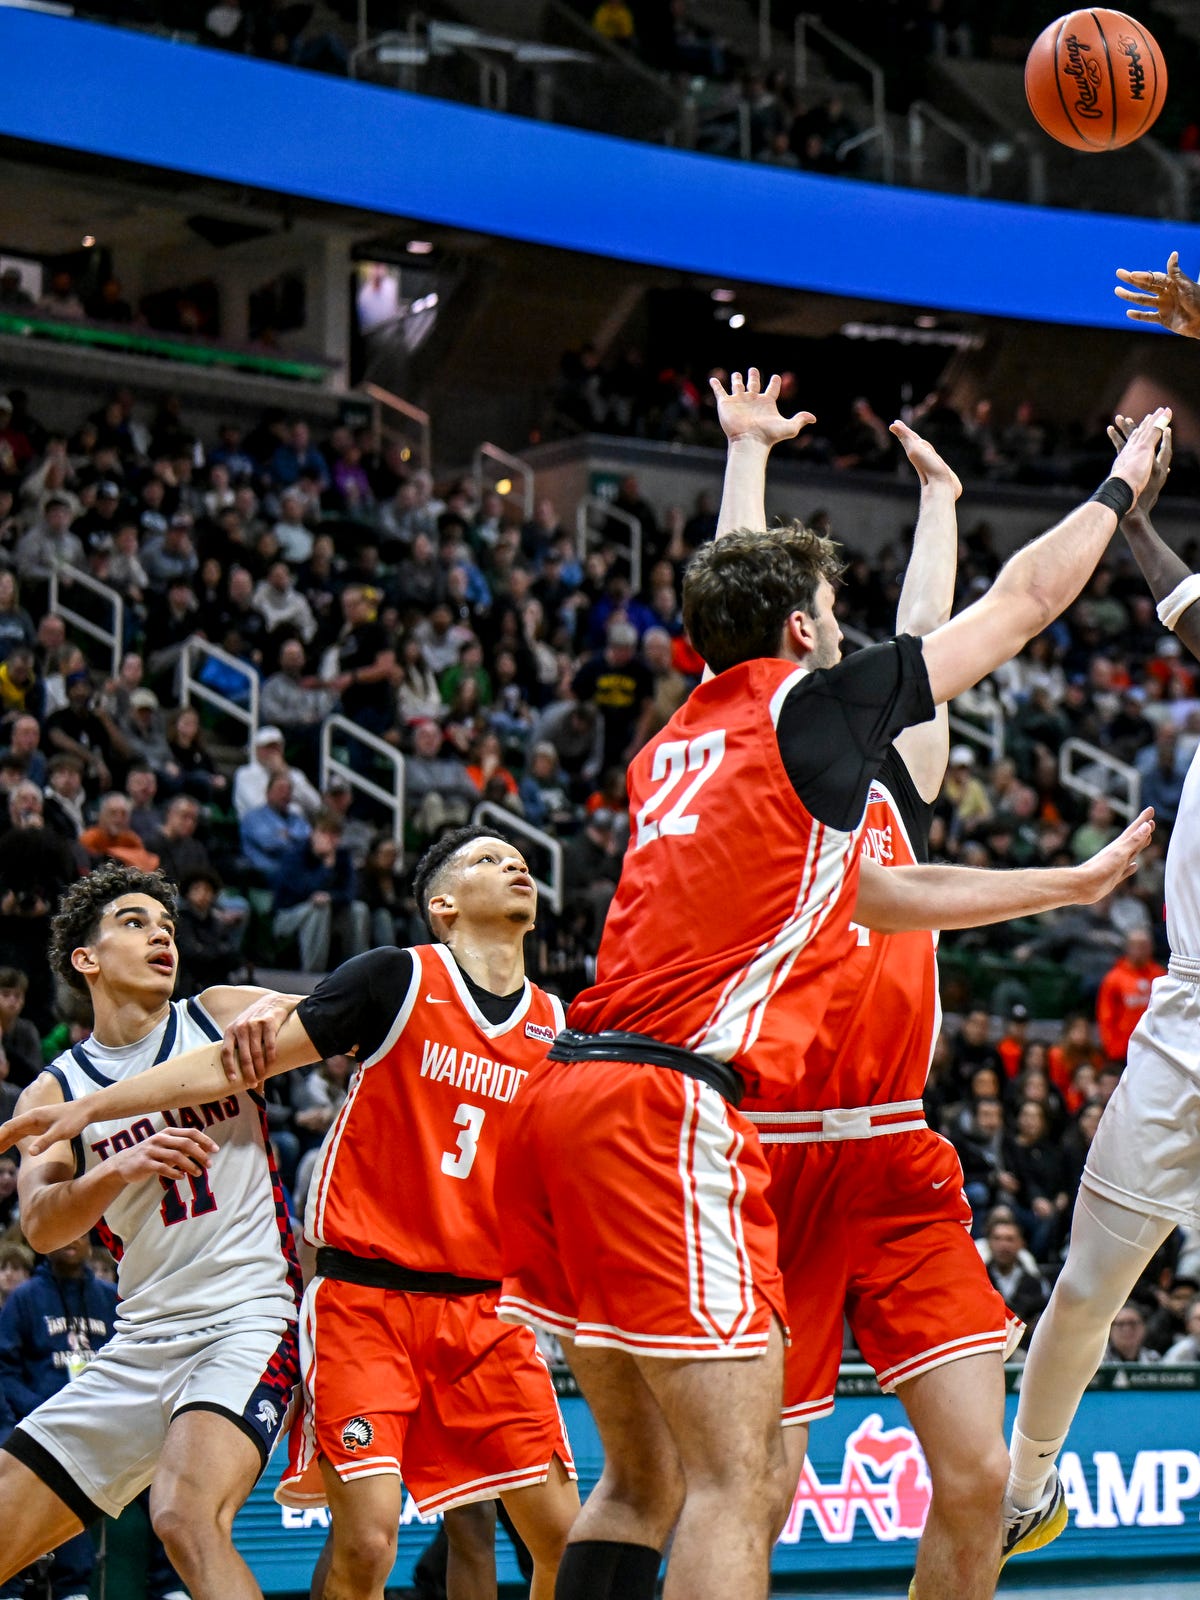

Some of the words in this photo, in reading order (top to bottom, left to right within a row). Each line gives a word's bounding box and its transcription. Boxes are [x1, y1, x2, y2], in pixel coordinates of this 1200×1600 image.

[1064, 34, 1103, 119] Rawlings
[634, 728, 727, 851] 22
[441, 1103, 486, 1180] 3
